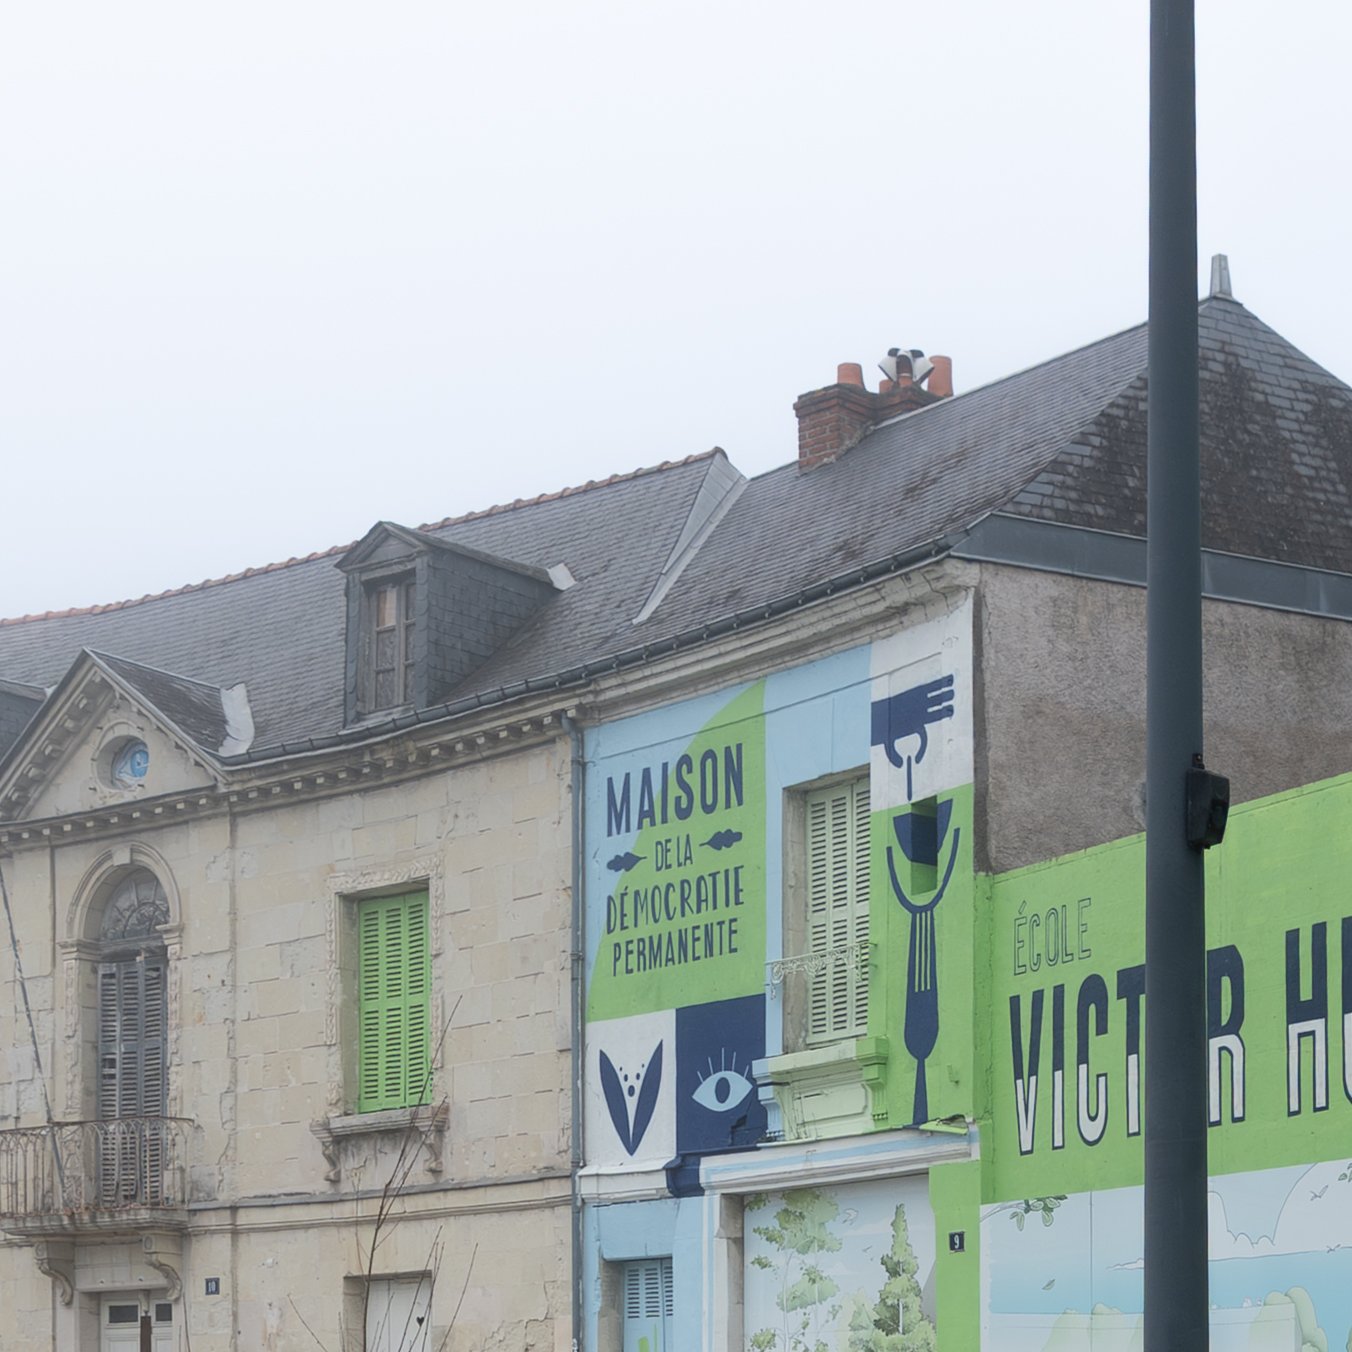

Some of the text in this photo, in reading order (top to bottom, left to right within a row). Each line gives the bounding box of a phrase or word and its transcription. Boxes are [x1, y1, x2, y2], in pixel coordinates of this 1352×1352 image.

[606, 743, 745, 838] MAISON
[655, 833, 694, 873] DE LA
[606, 864, 745, 936] DÉMOCRATIE
[612, 917, 739, 977] PERMANENTE
[1013, 897, 1092, 977] ÉCOLE
[1009, 943, 1246, 1157] VICTR
[953, 1233, 960, 1250] 9
[208, 1280, 216, 1292] 10
